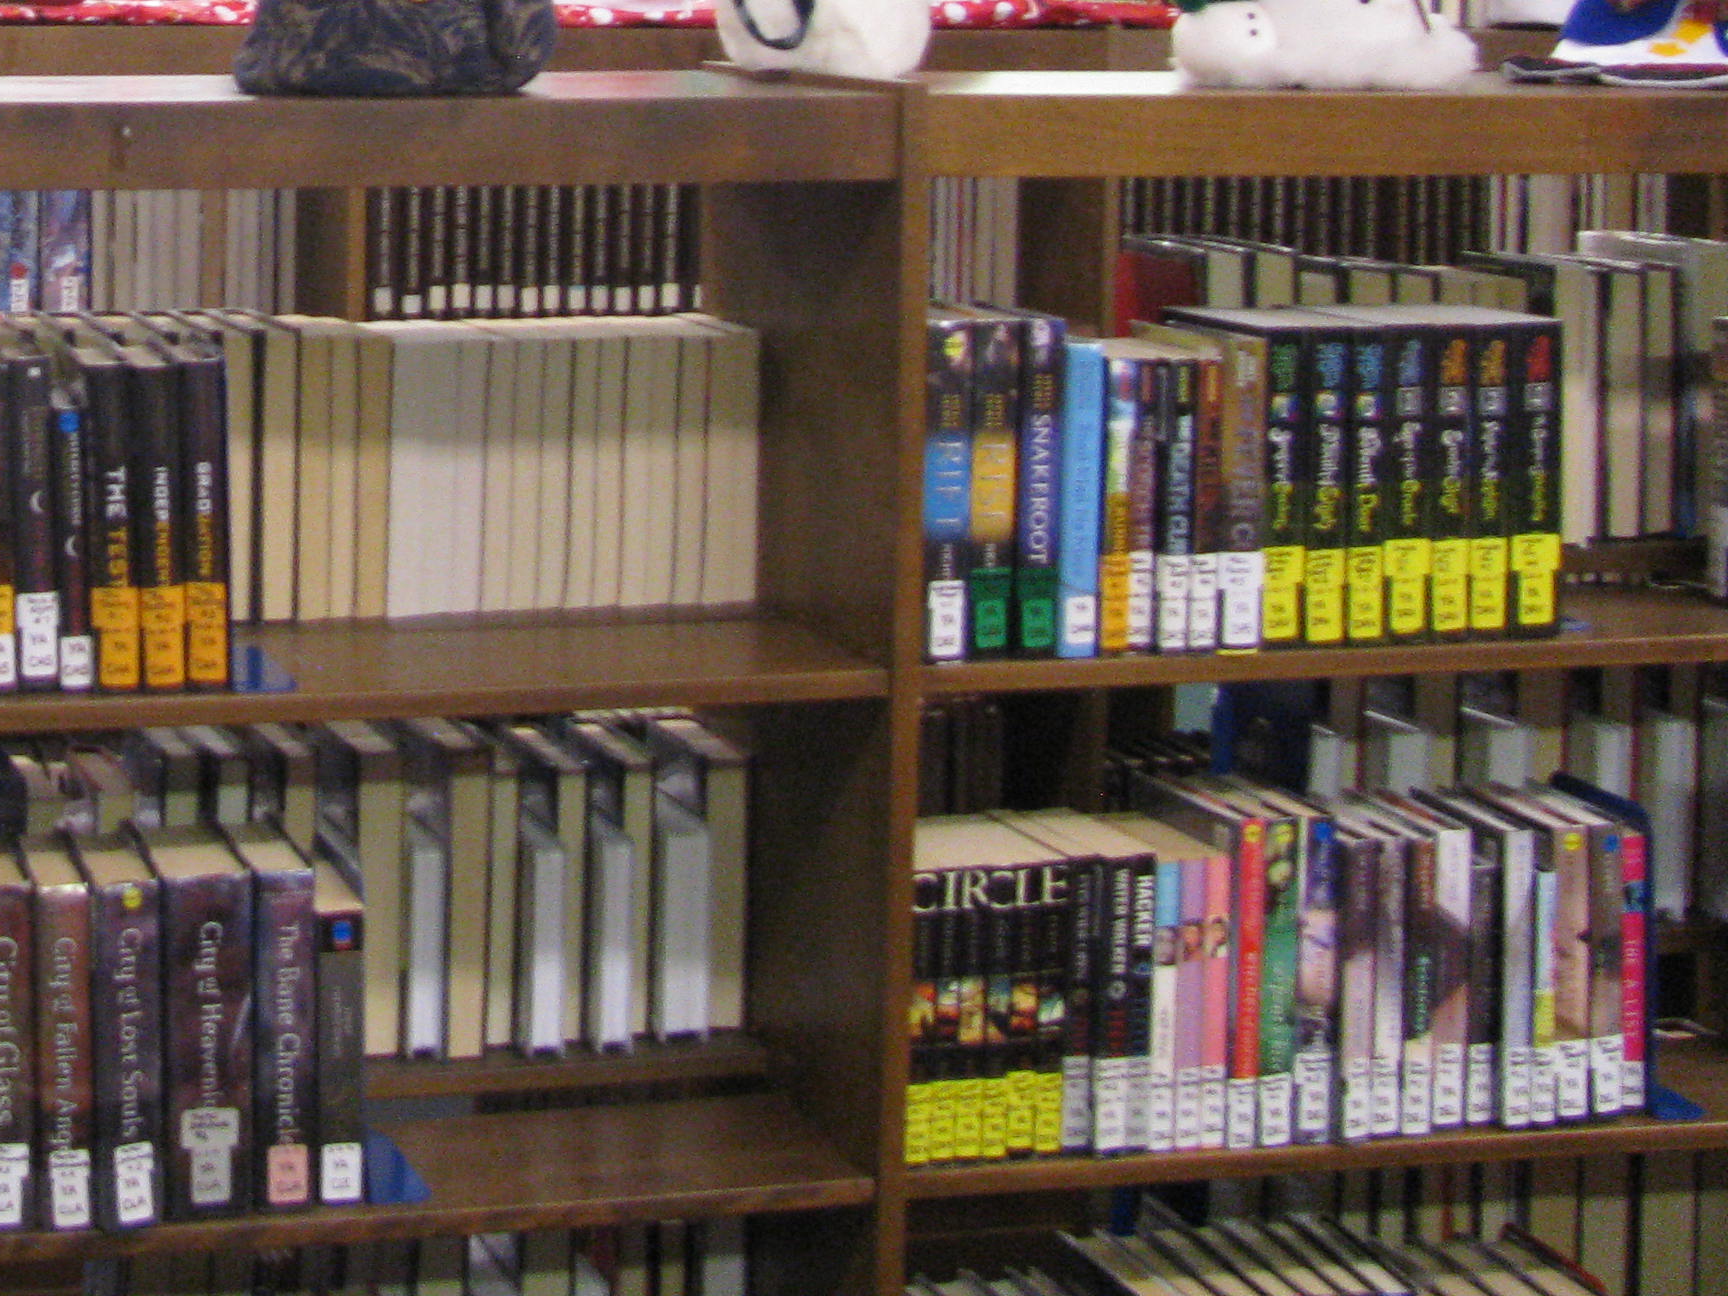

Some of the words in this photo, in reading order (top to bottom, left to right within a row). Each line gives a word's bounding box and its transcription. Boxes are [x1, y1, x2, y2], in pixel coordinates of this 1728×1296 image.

[105, 465, 128, 520] THE
[1029, 413, 1056, 565] SNAKEROOT
[911, 865, 1070, 913] CIRCLE
[49, 936, 78, 992] City
[113, 927, 142, 982] City
[193, 920, 224, 976] City
[275, 923, 301, 958] The
[116, 986, 142, 1009] of
[196, 978, 222, 999] of
[276, 965, 302, 1026] Bane
[54, 1023, 78, 1092] Fallen
[118, 1012, 142, 1064] Lost
[119, 1069, 144, 1139] Souls
